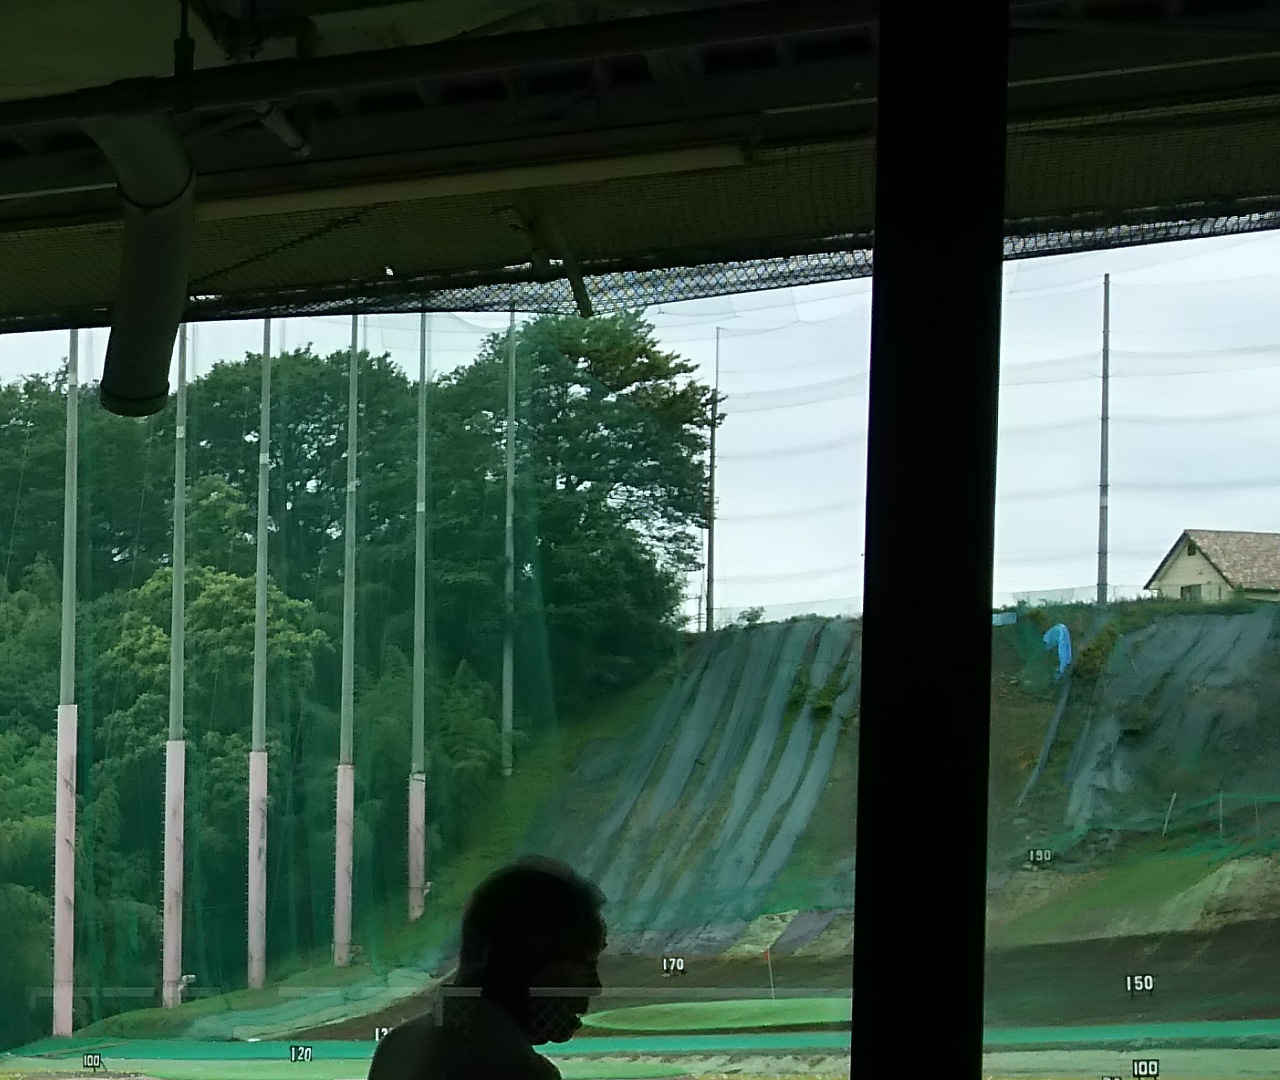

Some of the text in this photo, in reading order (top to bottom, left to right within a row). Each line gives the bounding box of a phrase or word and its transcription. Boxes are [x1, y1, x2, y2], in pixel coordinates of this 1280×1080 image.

[1030, 849, 1051, 861] 190
[663, 958, 684, 970] 170
[1126, 975, 1154, 991] 150
[84, 1054, 100, 1066] 100
[291, 1046, 312, 1061] 120
[1134, 1061, 1158, 1075] 100
